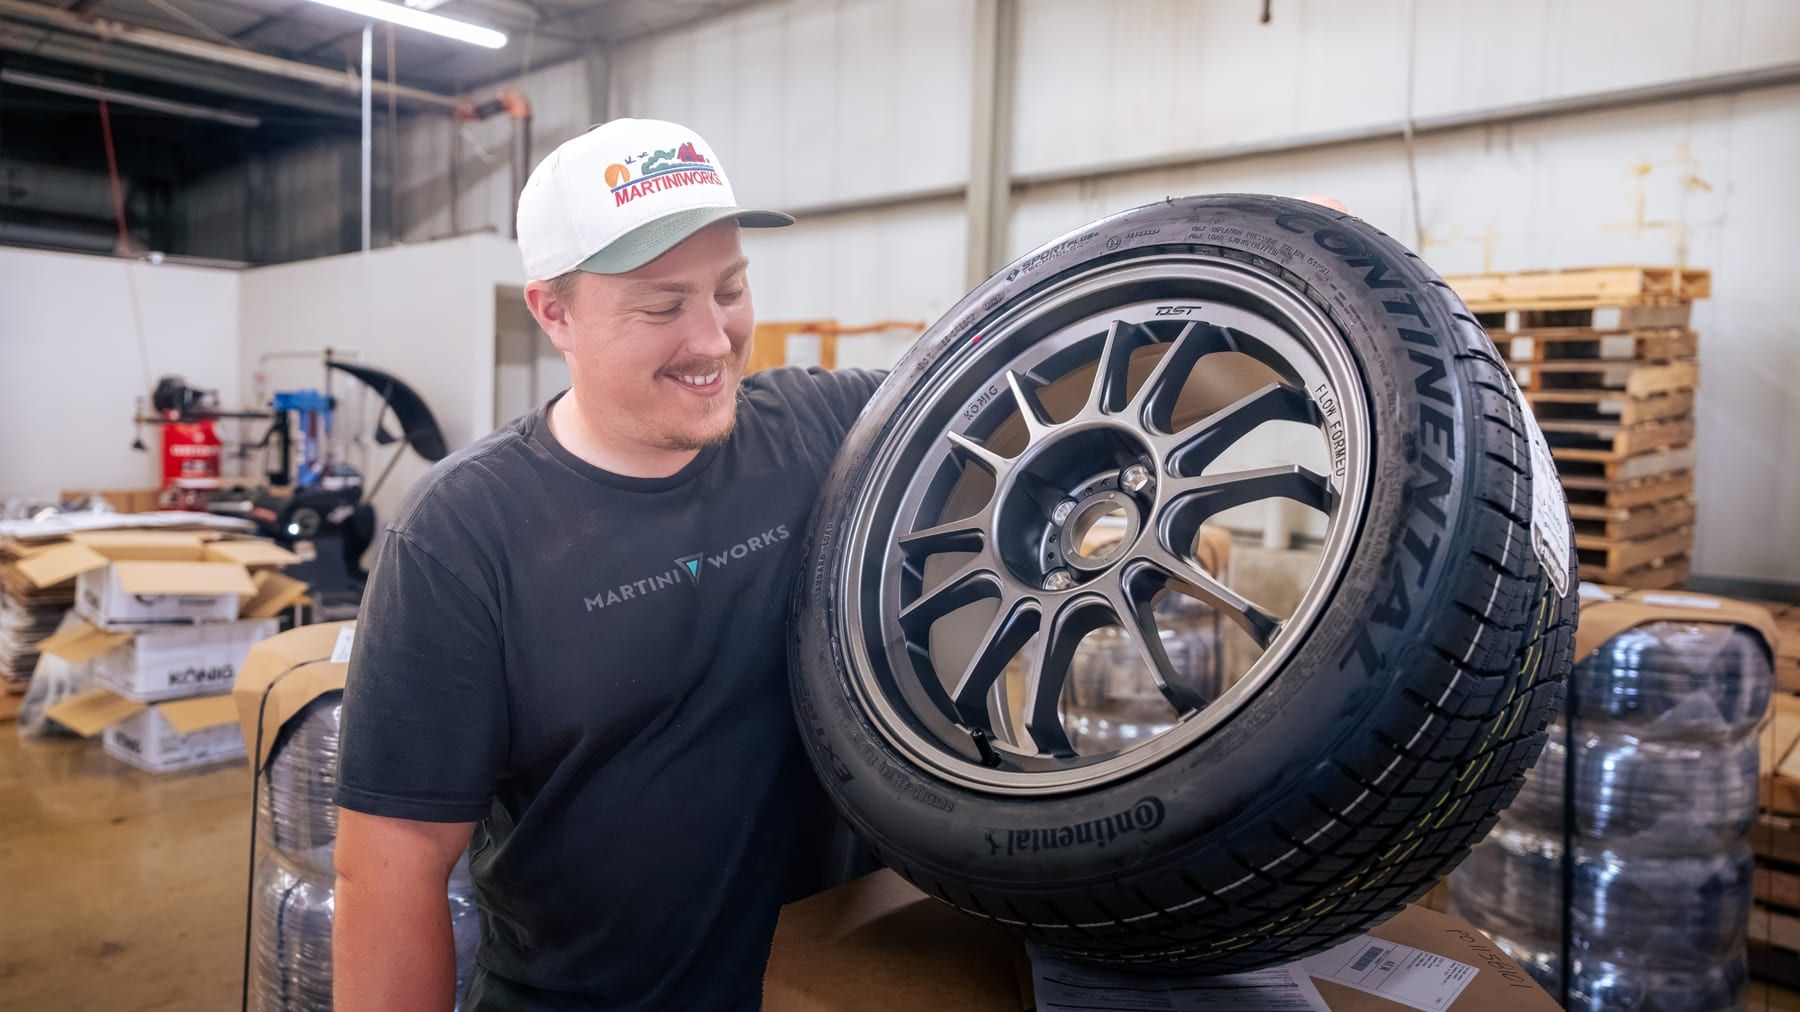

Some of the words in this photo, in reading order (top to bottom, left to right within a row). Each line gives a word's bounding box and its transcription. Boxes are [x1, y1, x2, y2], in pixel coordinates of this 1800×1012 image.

[614, 171, 724, 207] MARTINIWORKS
[963, 385, 998, 420] KÖNIG
[1315, 383, 1338, 417] FLOW
[1329, 421, 1346, 478] FORMED
[1275, 213, 1455, 678] CONTINENTAL
[584, 568, 682, 612] MARTINI
[707, 524, 790, 569] WORKS
[1007, 796, 1166, 856] Continental
